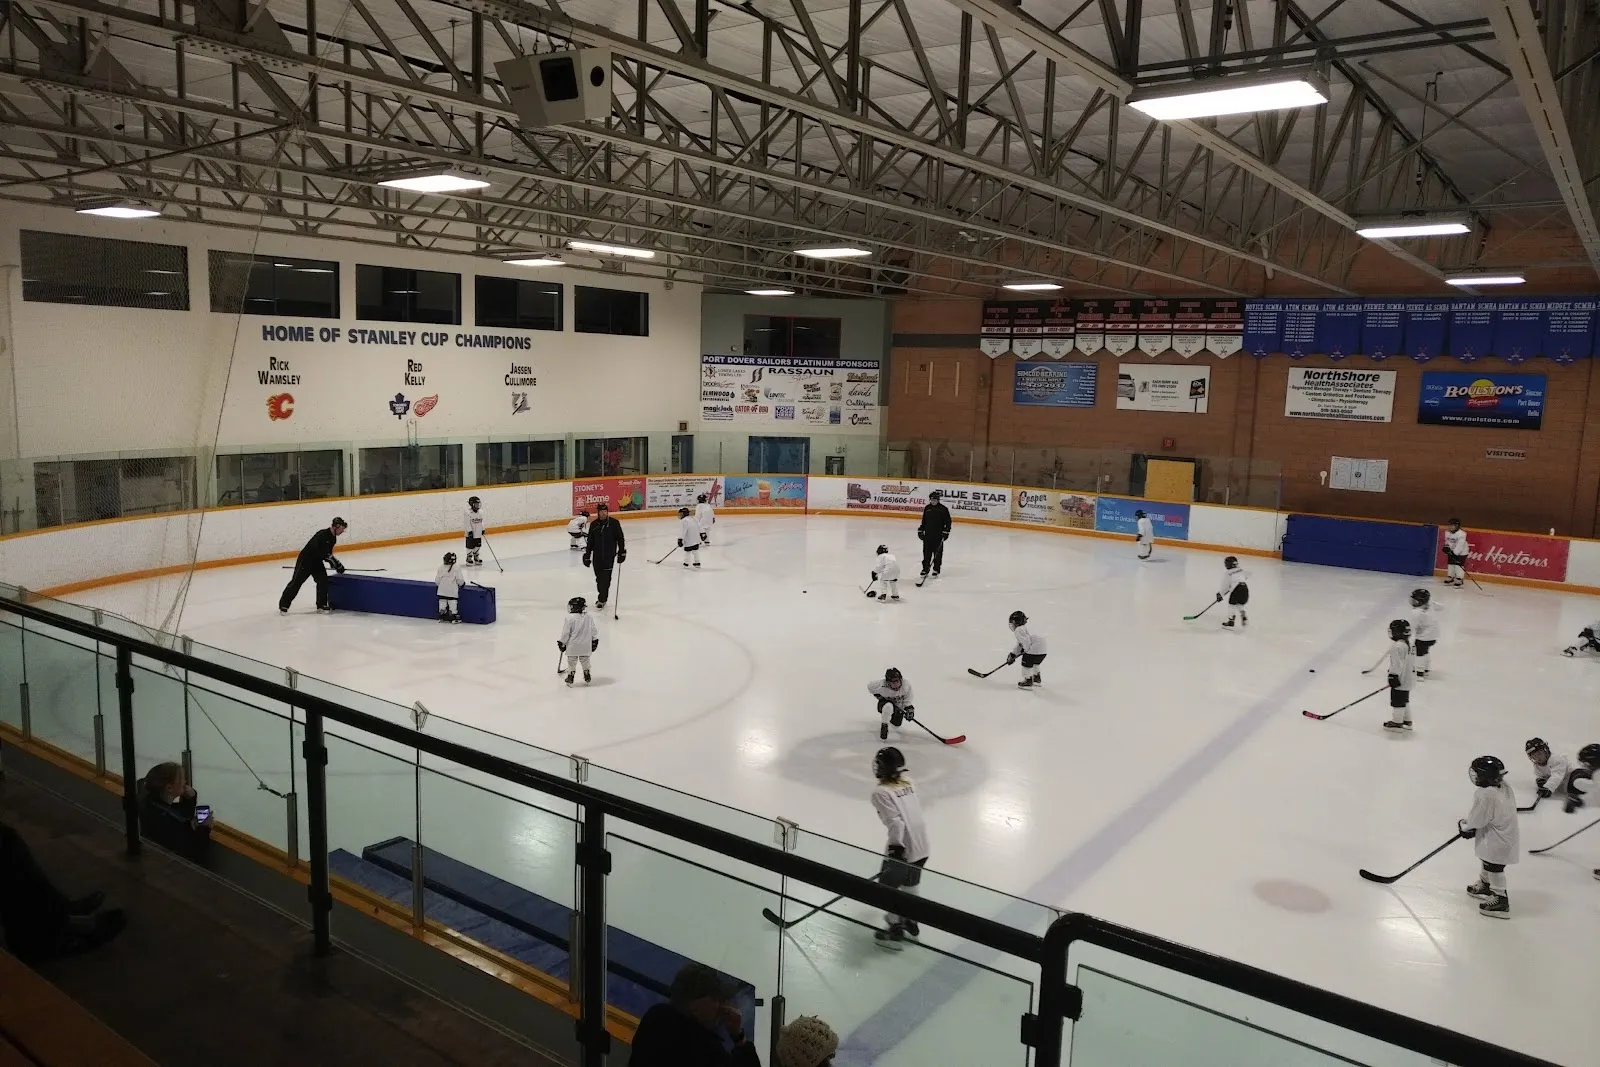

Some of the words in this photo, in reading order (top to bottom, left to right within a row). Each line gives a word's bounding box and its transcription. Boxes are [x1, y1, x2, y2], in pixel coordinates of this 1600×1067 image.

[262, 325, 314, 342] HOME
[319, 327, 341, 343] OF
[348, 328, 416, 345] STANLEY
[421, 331, 449, 346] CUP
[455, 333, 531, 350] CHAMPIONS
[757, 358, 791, 366] SAILORS
[794, 358, 834, 367] PLATINUM
[836, 360, 878, 368] SPONSORS
[768, 367, 834, 376] RASSAUN
[1304, 370, 1380, 382] NorthShore
[1304, 380, 1374, 389] HealthAssociates
[1442, 415, 1520, 424] www.roulstons.com
[1486, 450, 1526, 458] VISITORS
[574, 484, 604, 492] STONEY'S
[586, 494, 610, 503] Home
[936, 489, 968, 499] BLUE
[972, 492, 1006, 502] STAR
[1018, 491, 1047, 508] Cooper
[1485, 546, 1548, 568] Hortons
